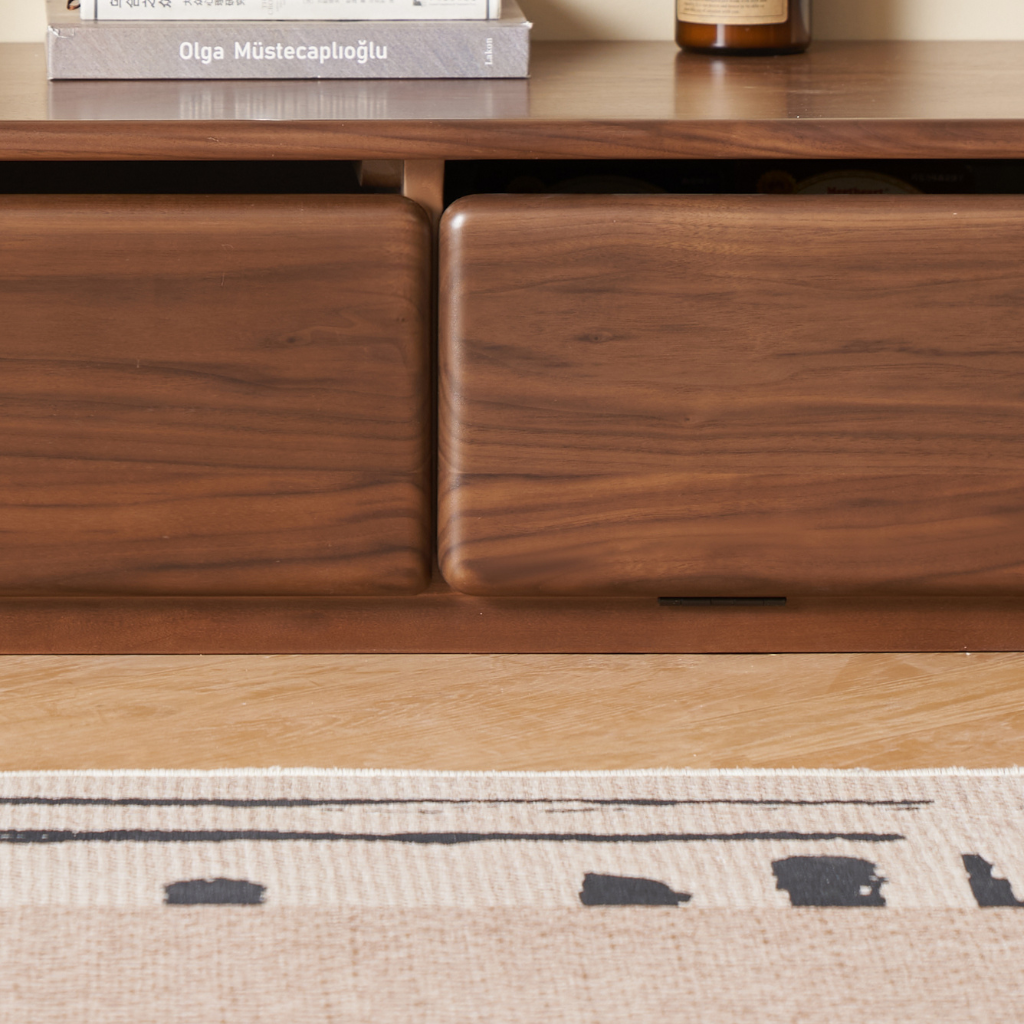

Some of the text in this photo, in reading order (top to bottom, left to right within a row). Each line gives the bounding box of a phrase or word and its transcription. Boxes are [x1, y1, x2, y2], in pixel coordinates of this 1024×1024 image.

[179, 40, 389, 65] Olga Müstecaplıoğlu
[484, 37, 494, 66] Lakon
